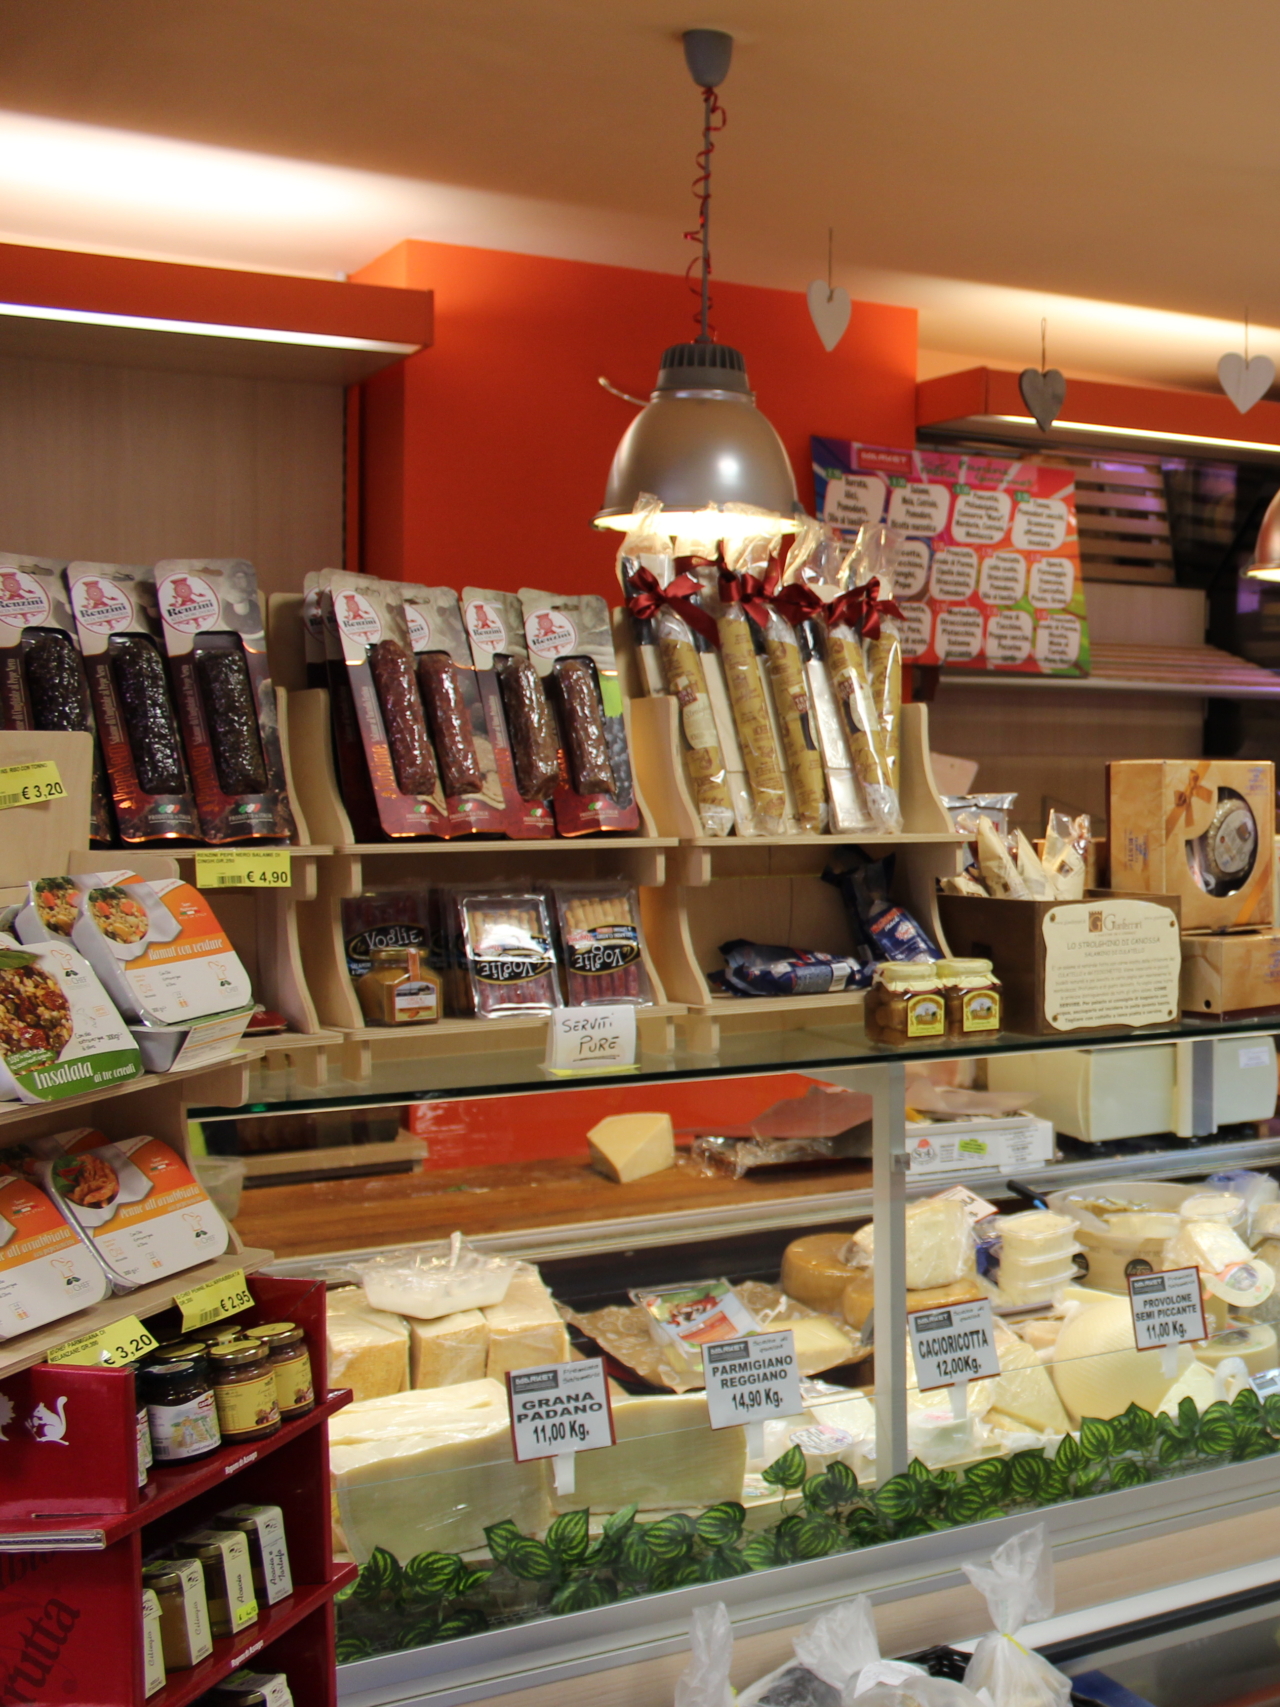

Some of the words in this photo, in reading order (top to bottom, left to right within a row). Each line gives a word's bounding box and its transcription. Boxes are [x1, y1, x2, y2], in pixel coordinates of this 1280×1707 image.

[79, 602, 127, 619] Renzini
[166, 599, 215, 617] Renzini
[343, 617, 378, 628] Renzini
[472, 627, 503, 637] Renzini
[532, 630, 573, 646] Renzini
[22, 786, 31, 800] €
[34, 782, 63, 799] 3,20
[246, 871, 256, 883] €
[259, 871, 288, 884] 4,90
[1131, 936, 1160, 946] CANOSSA
[579, 1035, 620, 1055] PURE
[33, 1061, 93, 1090] Insalata
[94, 1072, 102, 1083] ai
[102, 1070, 113, 1080] tre
[113, 1063, 136, 1077] cereali
[73, 1280, 91, 1293] CHEF
[220, 1299, 229, 1312] €
[229, 1290, 251, 1311] 2,95
[1143, 1293, 1193, 1309] PROVOLONE
[1135, 1310, 1155, 1322] SEMI
[1157, 1304, 1197, 1318] PICCANTE
[1146, 1321, 1170, 1341] 11,00
[1172, 1320, 1188, 1339] Kg.
[115, 1334, 153, 1359] 3,20
[918, 1328, 989, 1360] CACIORICOTTA
[712, 1355, 793, 1378] PARMIGIANO
[720, 1369, 788, 1390] REGGIANO
[521, 1391, 596, 1411] GRANA
[731, 1389, 762, 1413] 14,90
[764, 1388, 784, 1408] Kg.
[516, 1402, 603, 1424] PADANO
[533, 1422, 566, 1446] 11,00
[569, 1420, 590, 1442] Kg.
[2, 1598, 80, 1706] rutta
